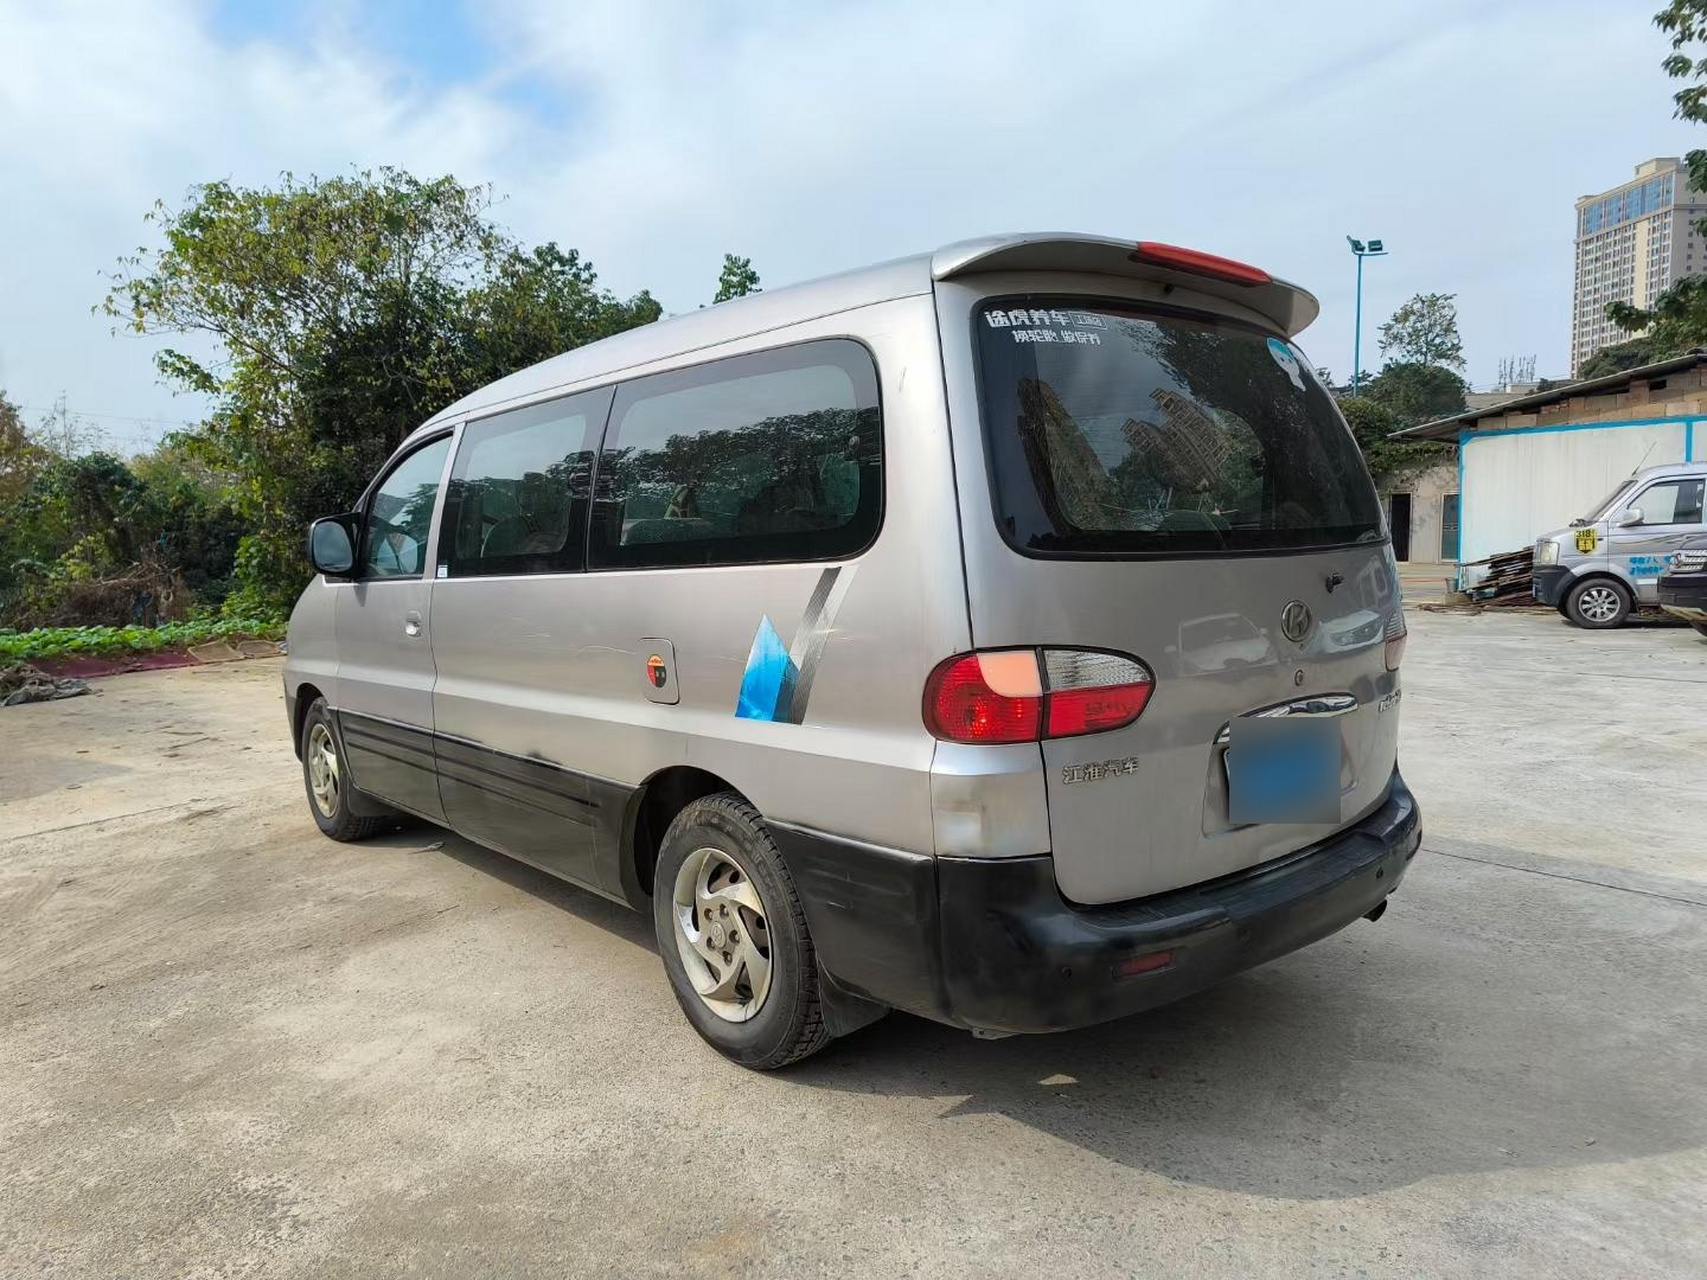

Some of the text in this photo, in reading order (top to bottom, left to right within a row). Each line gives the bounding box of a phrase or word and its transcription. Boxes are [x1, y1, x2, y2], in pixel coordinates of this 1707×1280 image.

[984, 309, 1070, 328] 途虎养车
[1012, 329, 1101, 345] 换轮胎 做保养
[1062, 757, 1138, 785] 江淮汽车
